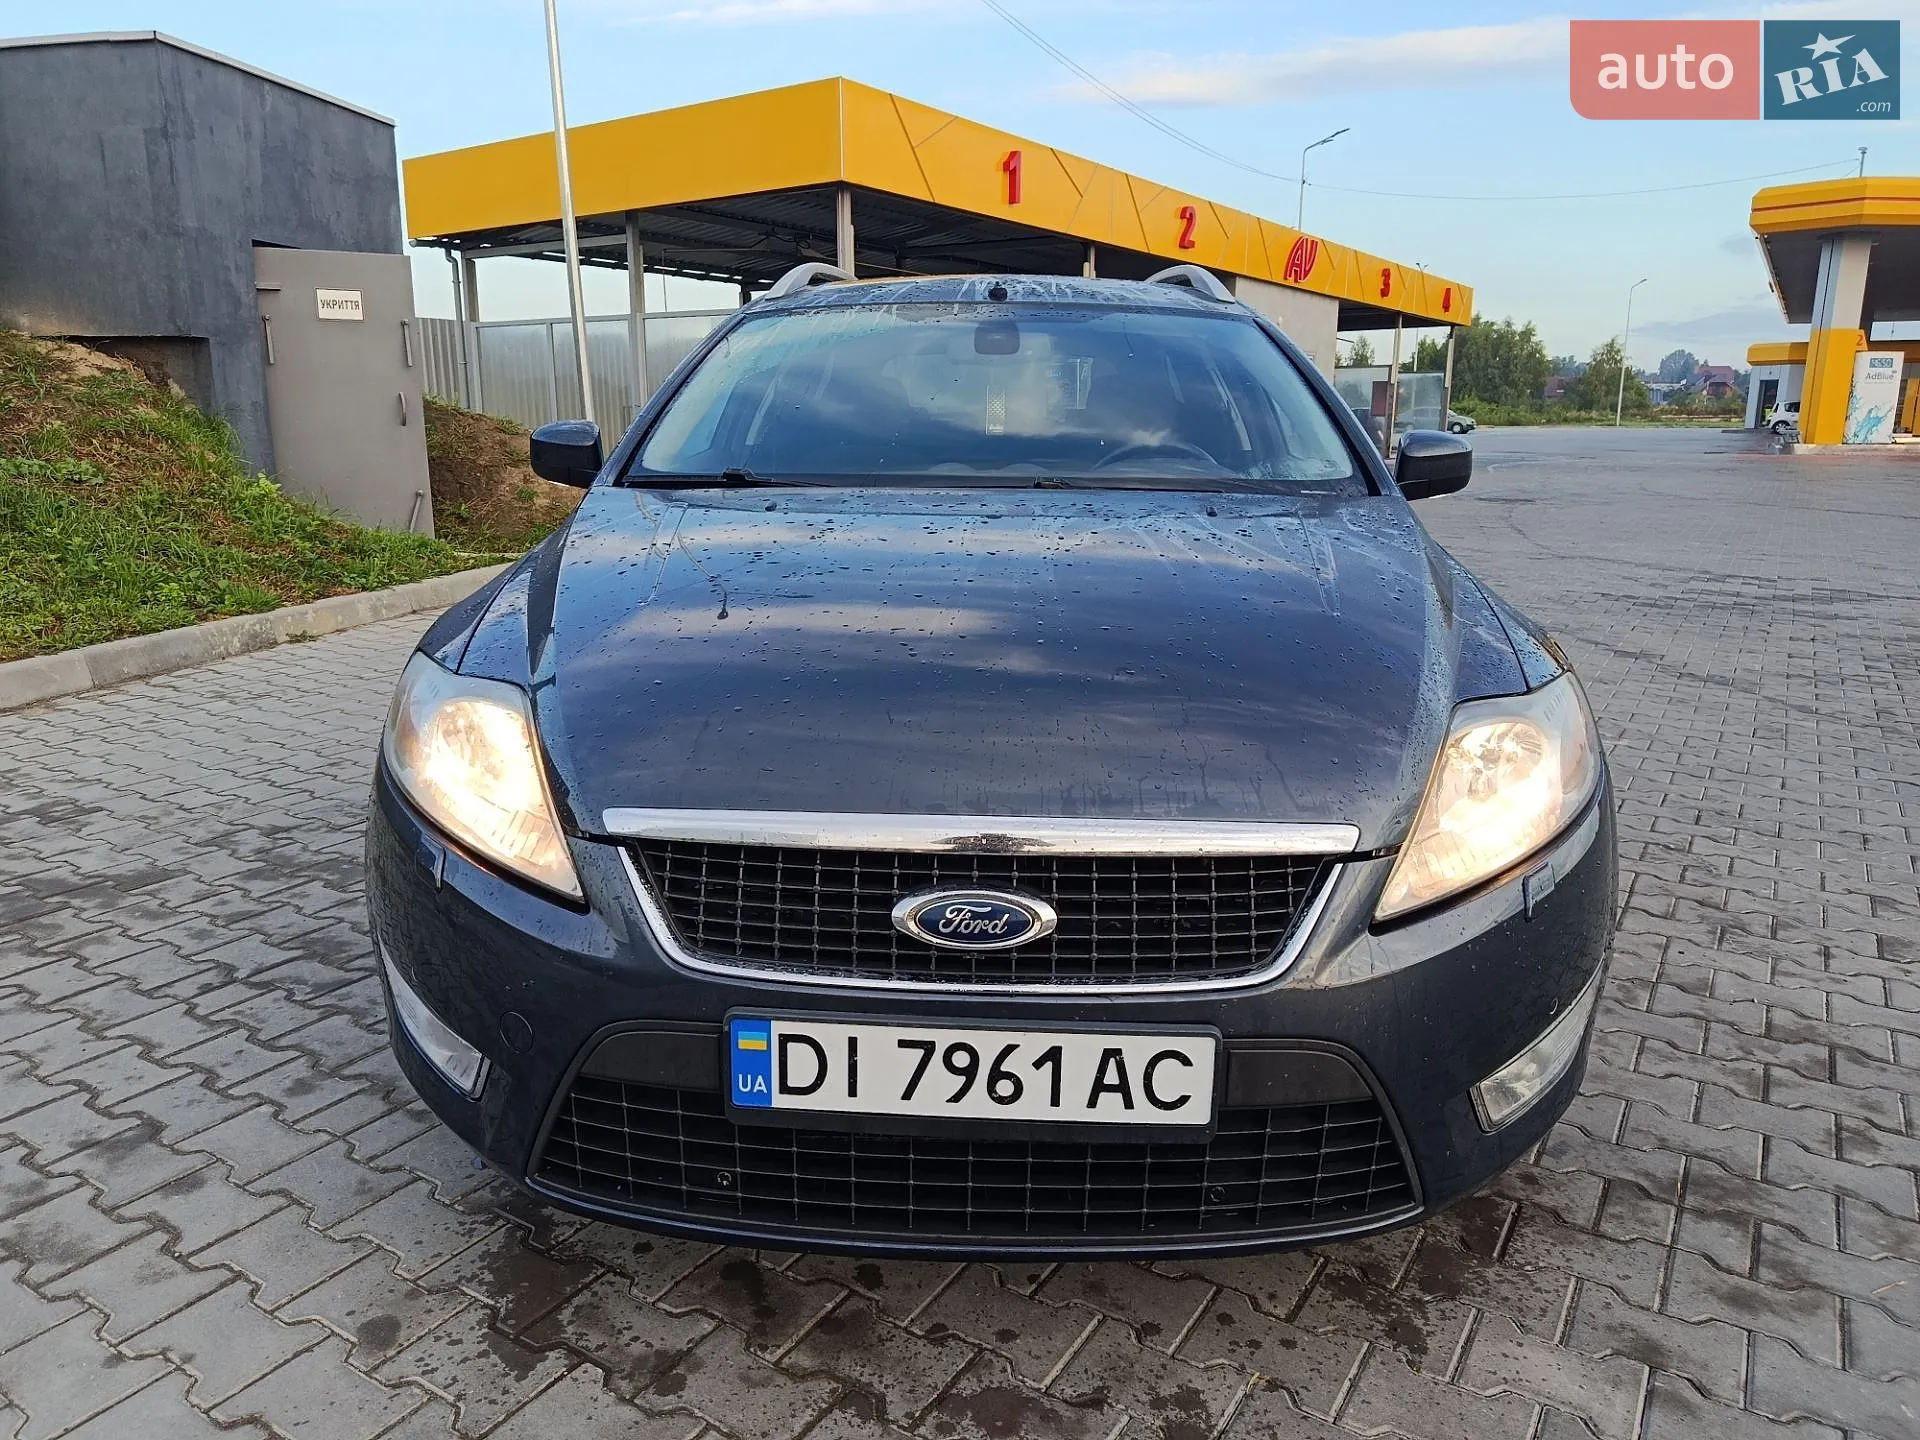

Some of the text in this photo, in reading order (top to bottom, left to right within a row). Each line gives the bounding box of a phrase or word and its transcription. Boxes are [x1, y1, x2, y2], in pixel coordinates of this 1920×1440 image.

[1003, 150, 1022, 205] 1
[1178, 206, 1196, 249] 2
[1380, 267, 1391, 298] 3
[320, 299, 360, 310] УКРИТТЯ
[1442, 287, 1452, 313] 4
[1856, 334, 1864, 346] 2
[1865, 371, 1894, 380] AdBlue
[938, 905, 1010, 934] Ford
[737, 1073, 768, 1095] UA
[778, 1033, 1194, 1112] DI 7961 AC
